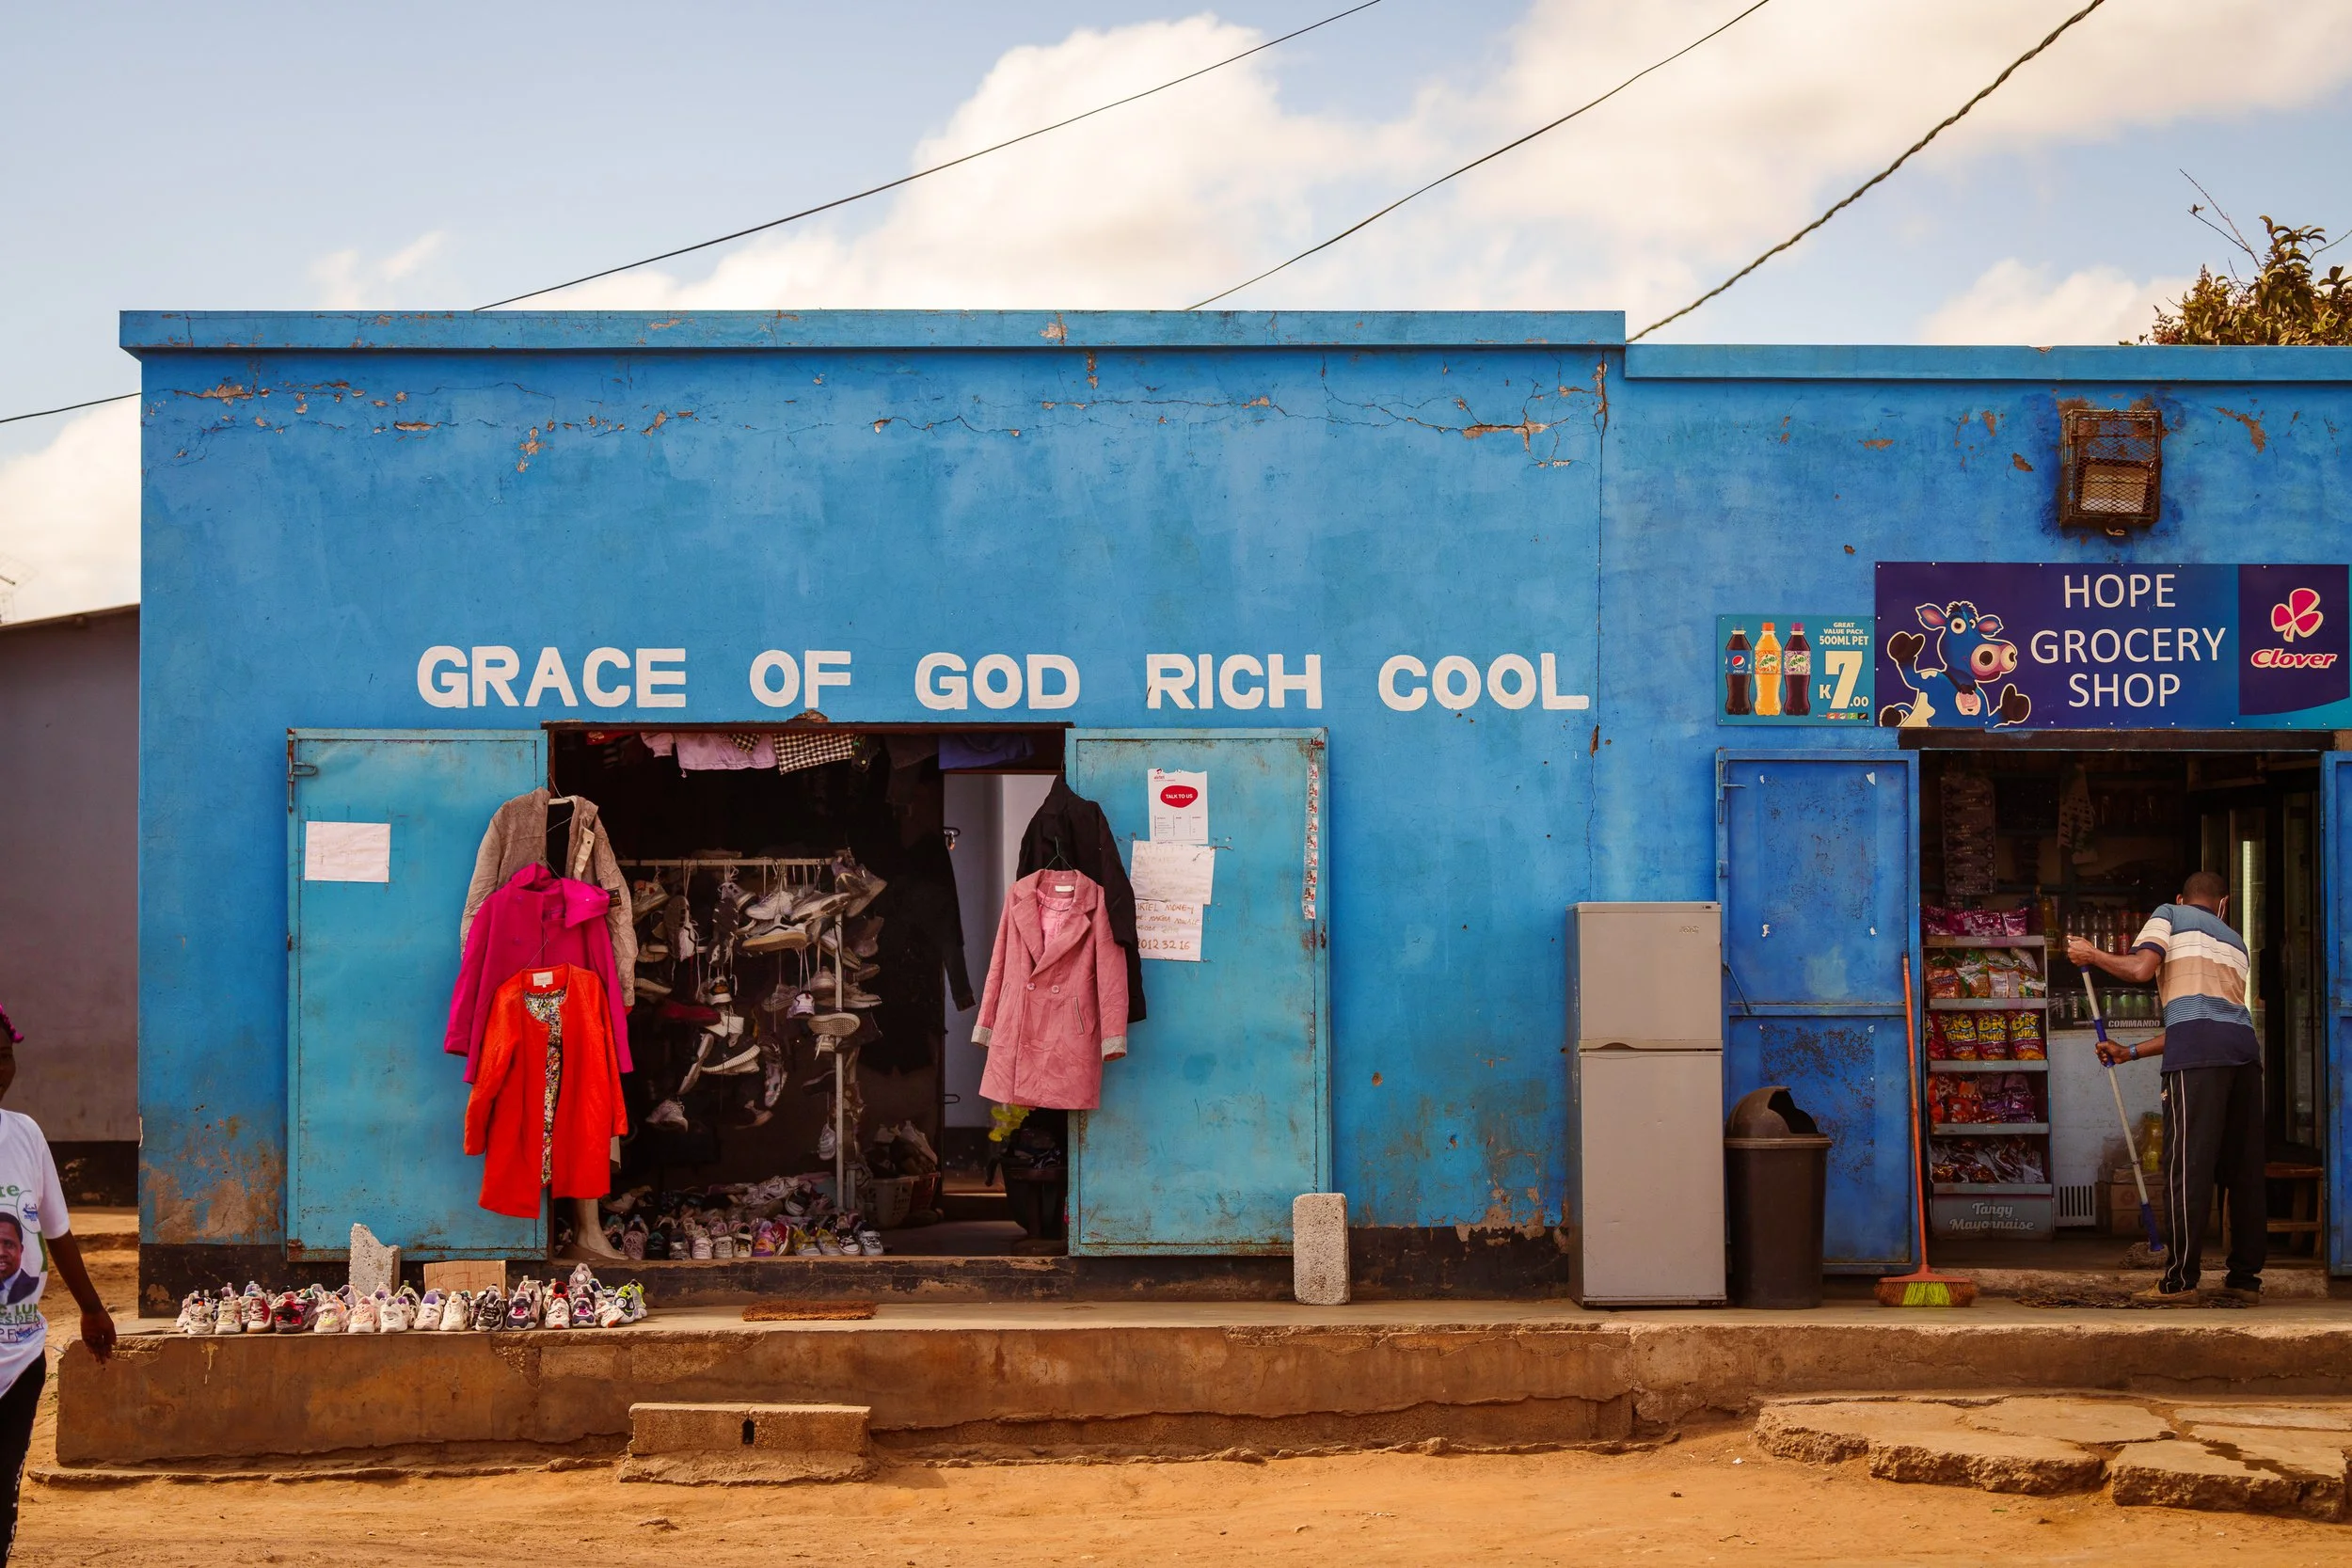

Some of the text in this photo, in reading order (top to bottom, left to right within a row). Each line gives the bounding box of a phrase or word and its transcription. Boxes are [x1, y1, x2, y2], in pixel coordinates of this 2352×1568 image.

[2064, 574, 2176, 609] HOPE
[1820, 635, 1869, 645] 500ML PET
[2030, 627, 2226, 664] GROCERY
[2250, 648, 2338, 669] Clover
[417, 645, 1590, 712] GRACE OF GOD RICH COOL
[2069, 673, 2181, 707] SHOP
[1162, 940, 1176, 950] 32
[1179, 940, 1191, 950] 16
[2107, 1020, 2161, 1028] COMMANDO
[1972, 1202, 2013, 1218] Tangy
